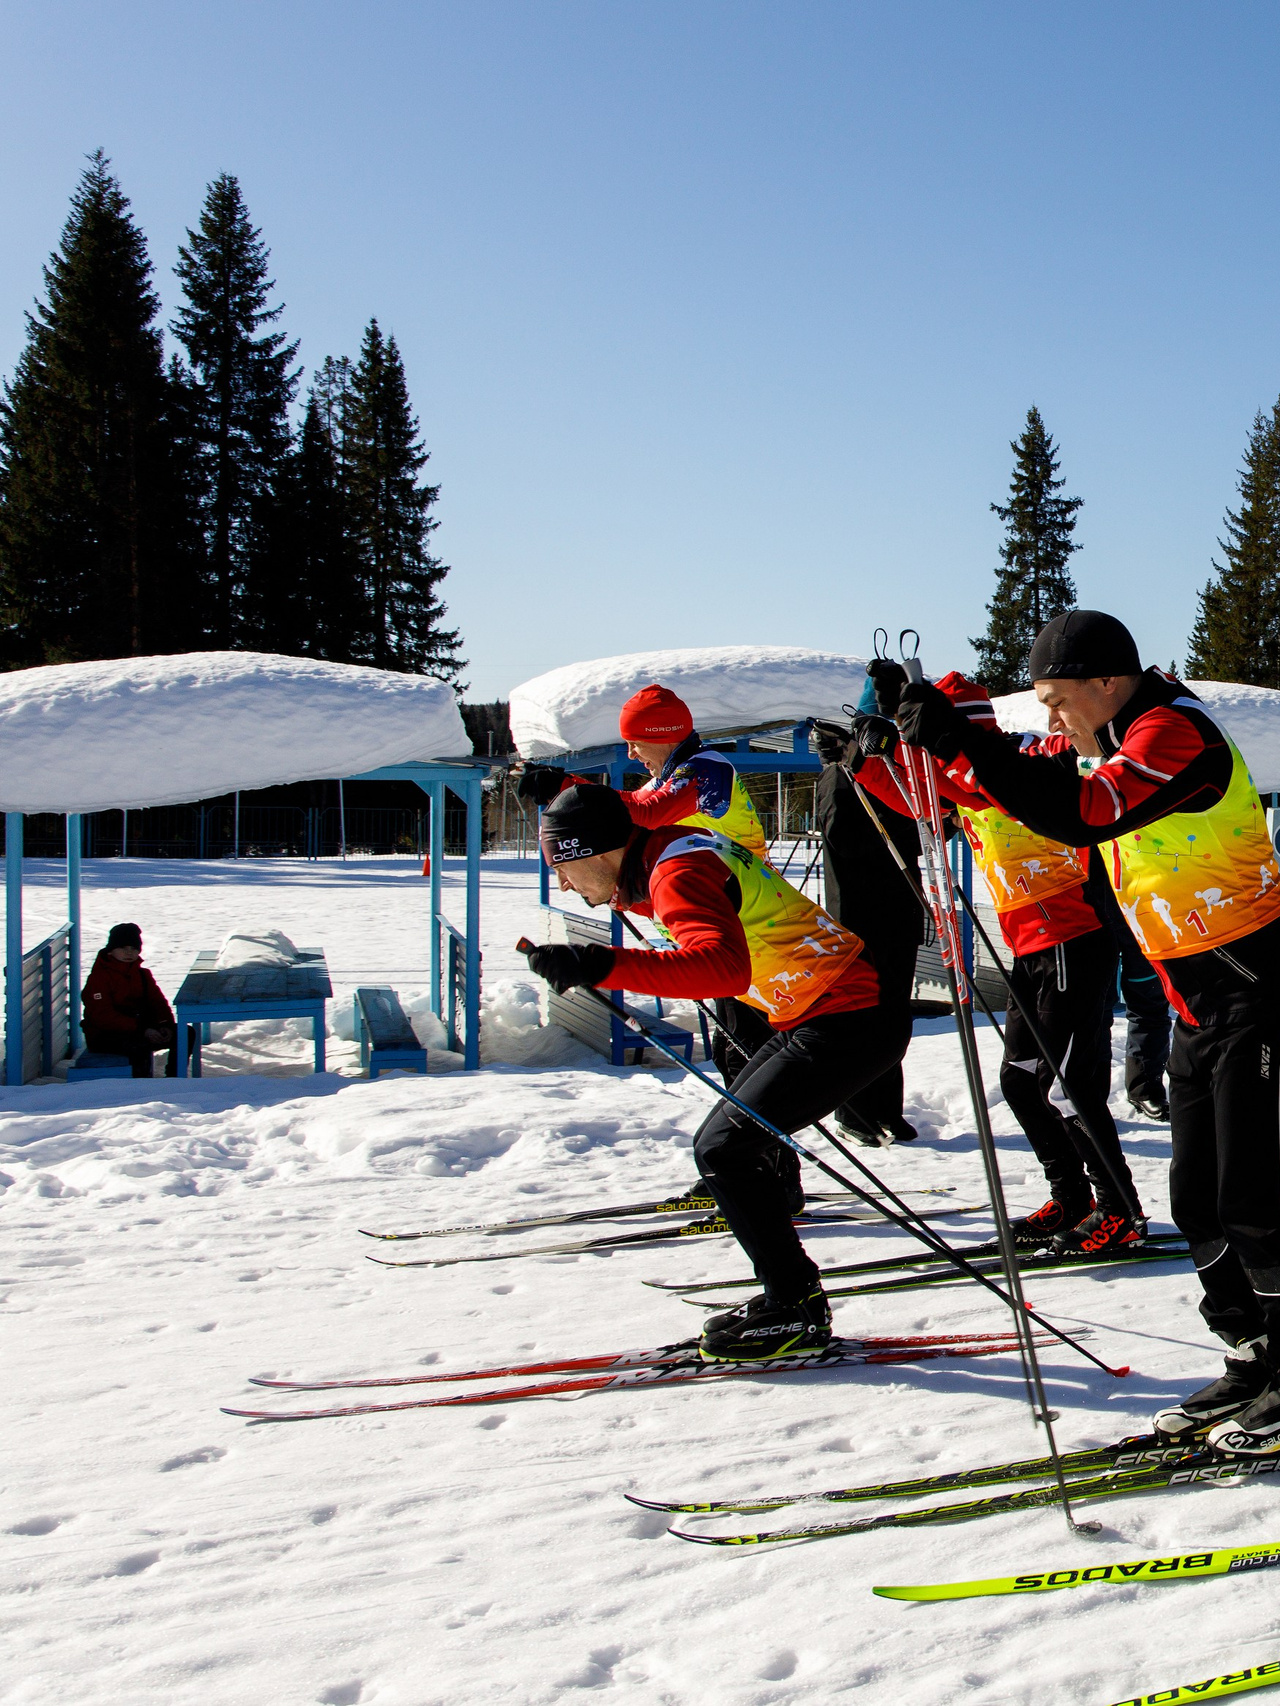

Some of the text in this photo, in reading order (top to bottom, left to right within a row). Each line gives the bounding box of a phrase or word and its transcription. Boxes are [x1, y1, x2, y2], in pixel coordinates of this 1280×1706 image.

[644, 724, 684, 732] NORDSKI
[962, 815, 985, 860] 4
[552, 848, 593, 862] odlo
[1015, 874, 1031, 895] 1
[1185, 909, 1209, 936] 1
[740, 1321, 806, 1339] FISCHE
[1013, 1552, 1214, 1590] BRADOS
[1231, 1556, 1264, 1568] CUP
